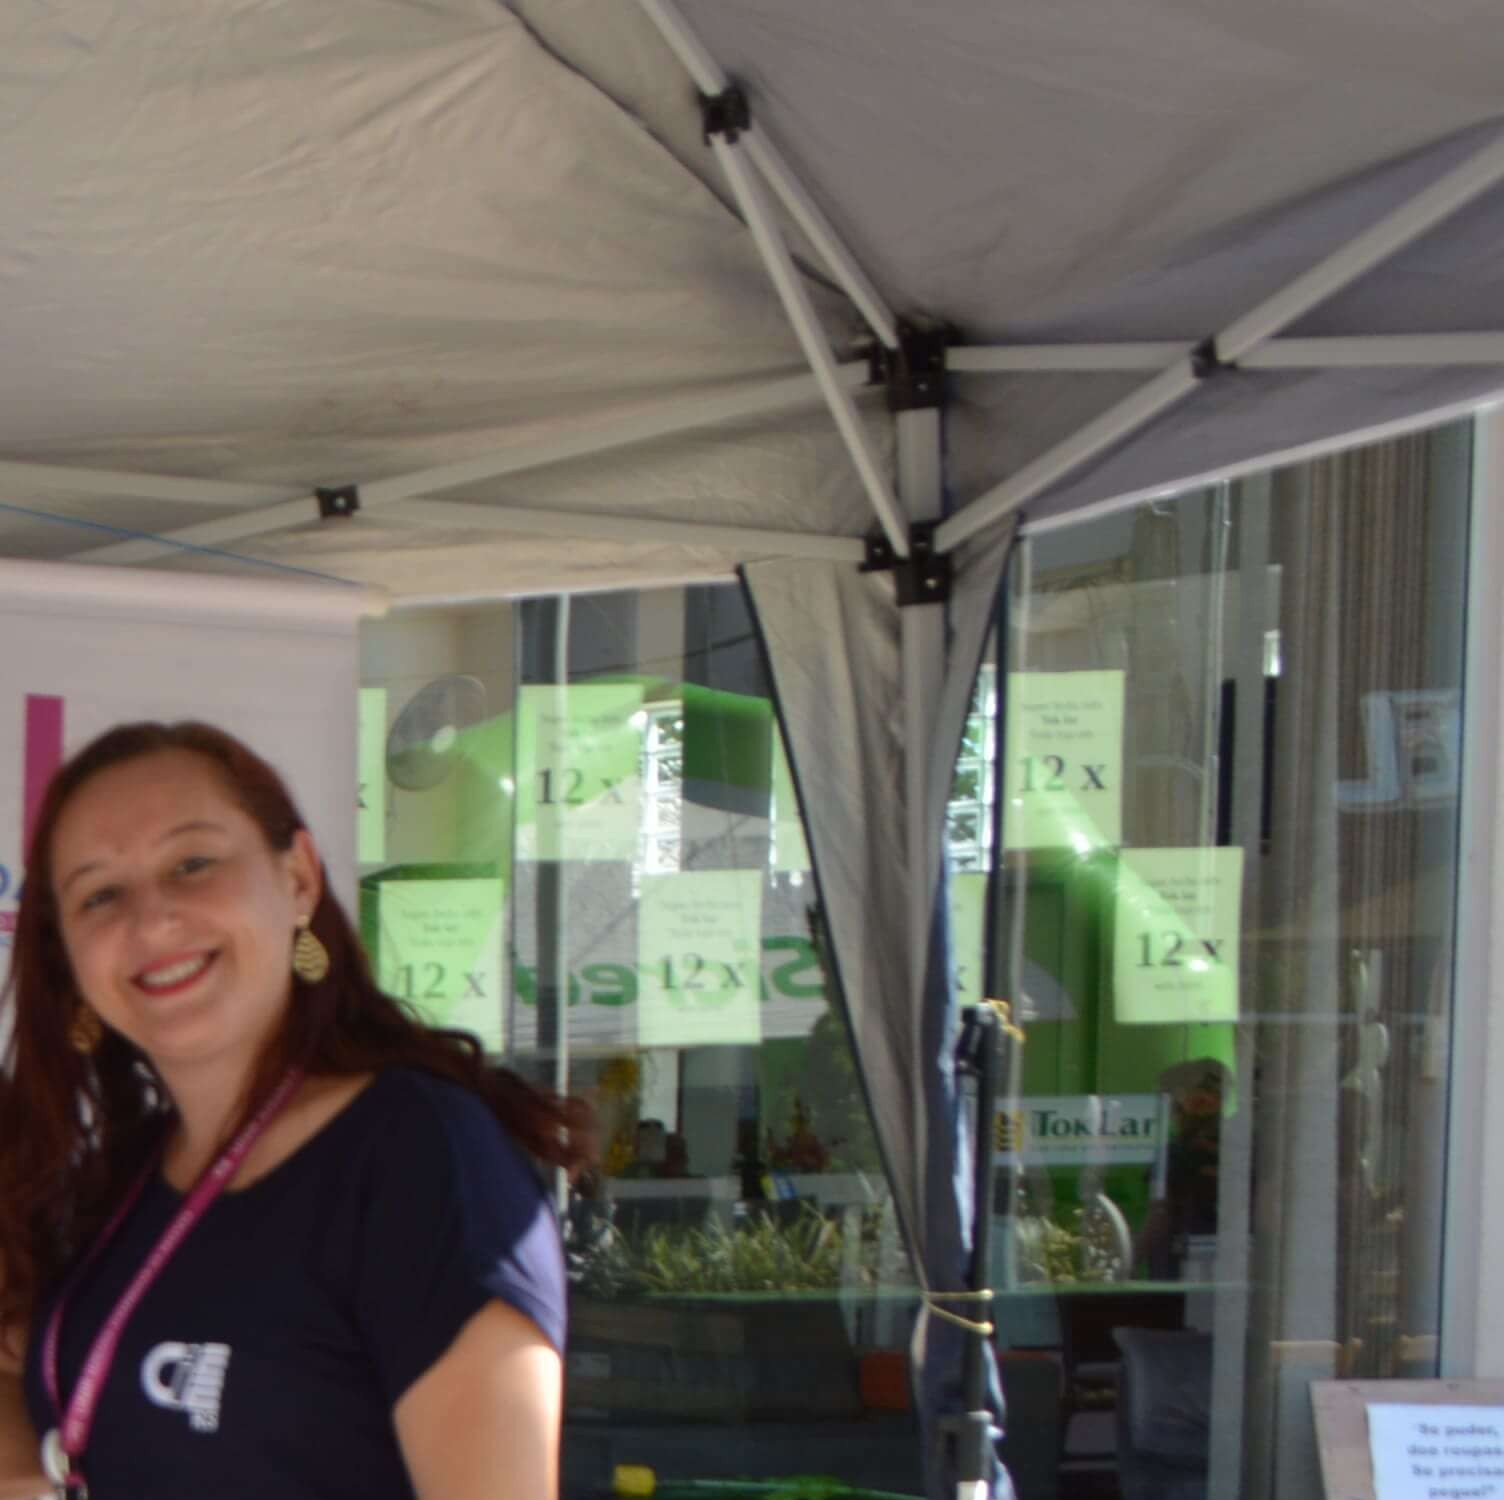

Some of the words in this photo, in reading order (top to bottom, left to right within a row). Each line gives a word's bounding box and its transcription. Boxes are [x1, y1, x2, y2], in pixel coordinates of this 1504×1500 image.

[537, 767, 584, 805] 12
[1019, 755, 1066, 792] 12
[1080, 764, 1107, 791] x
[1137, 931, 1183, 967] 12
[400, 962, 446, 999] 12
[661, 953, 706, 990] 12
